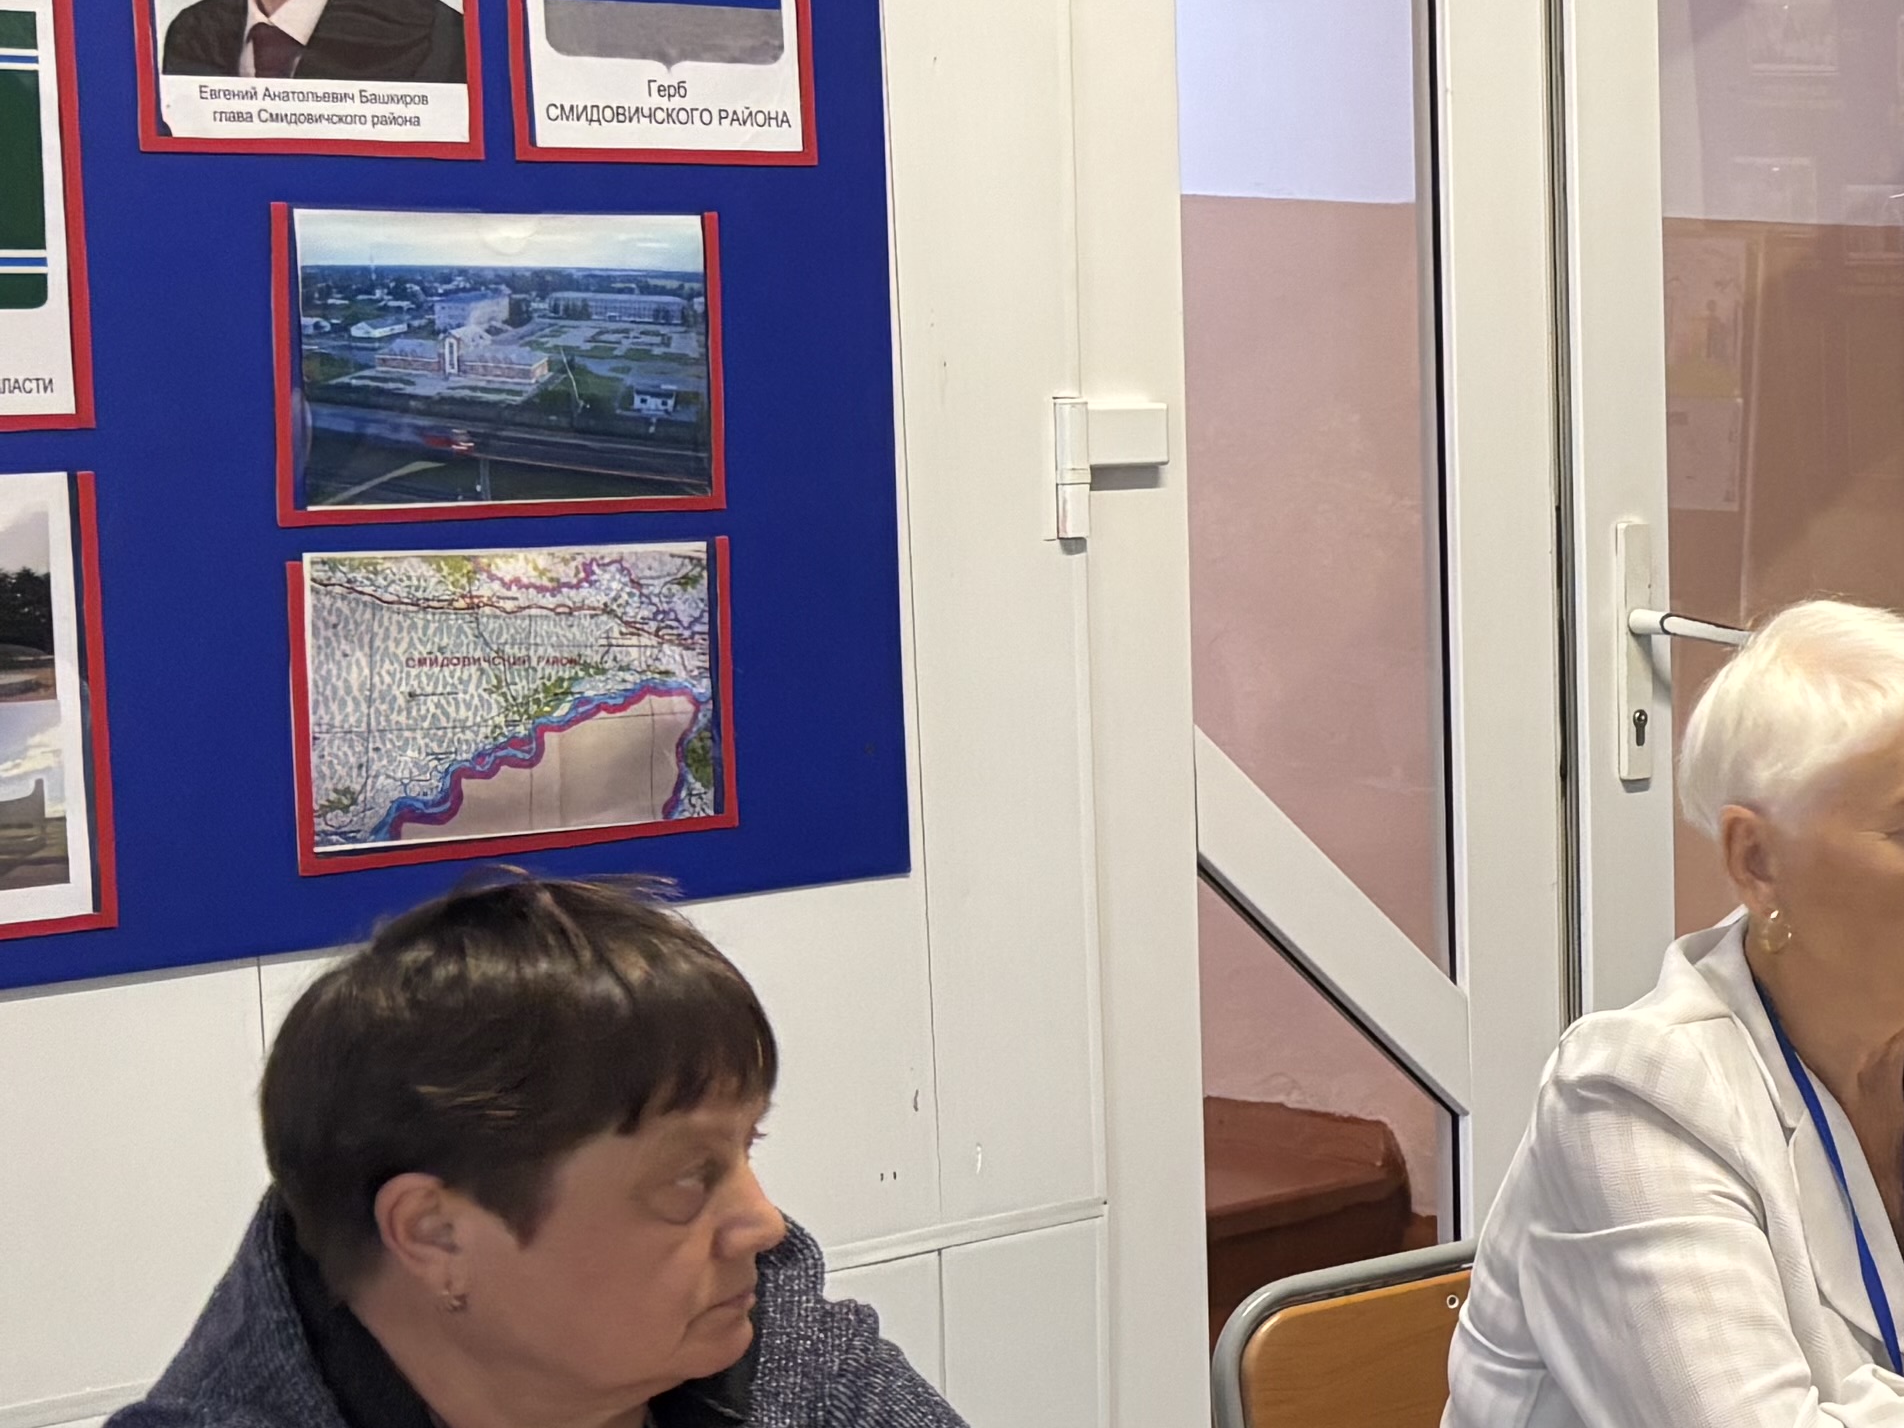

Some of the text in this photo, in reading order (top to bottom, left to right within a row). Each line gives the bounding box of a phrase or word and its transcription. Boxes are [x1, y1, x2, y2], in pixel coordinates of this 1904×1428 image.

[199, 84, 429, 107] Евгений Анатольевич Башкиров
[647, 79, 688, 101] Герб
[213, 108, 421, 130] глава Смидовичского района
[546, 102, 792, 129] СМИДОВИЧСКОГО РАЙОНА
[0, 377, 54, 394] ЛАСТИ
